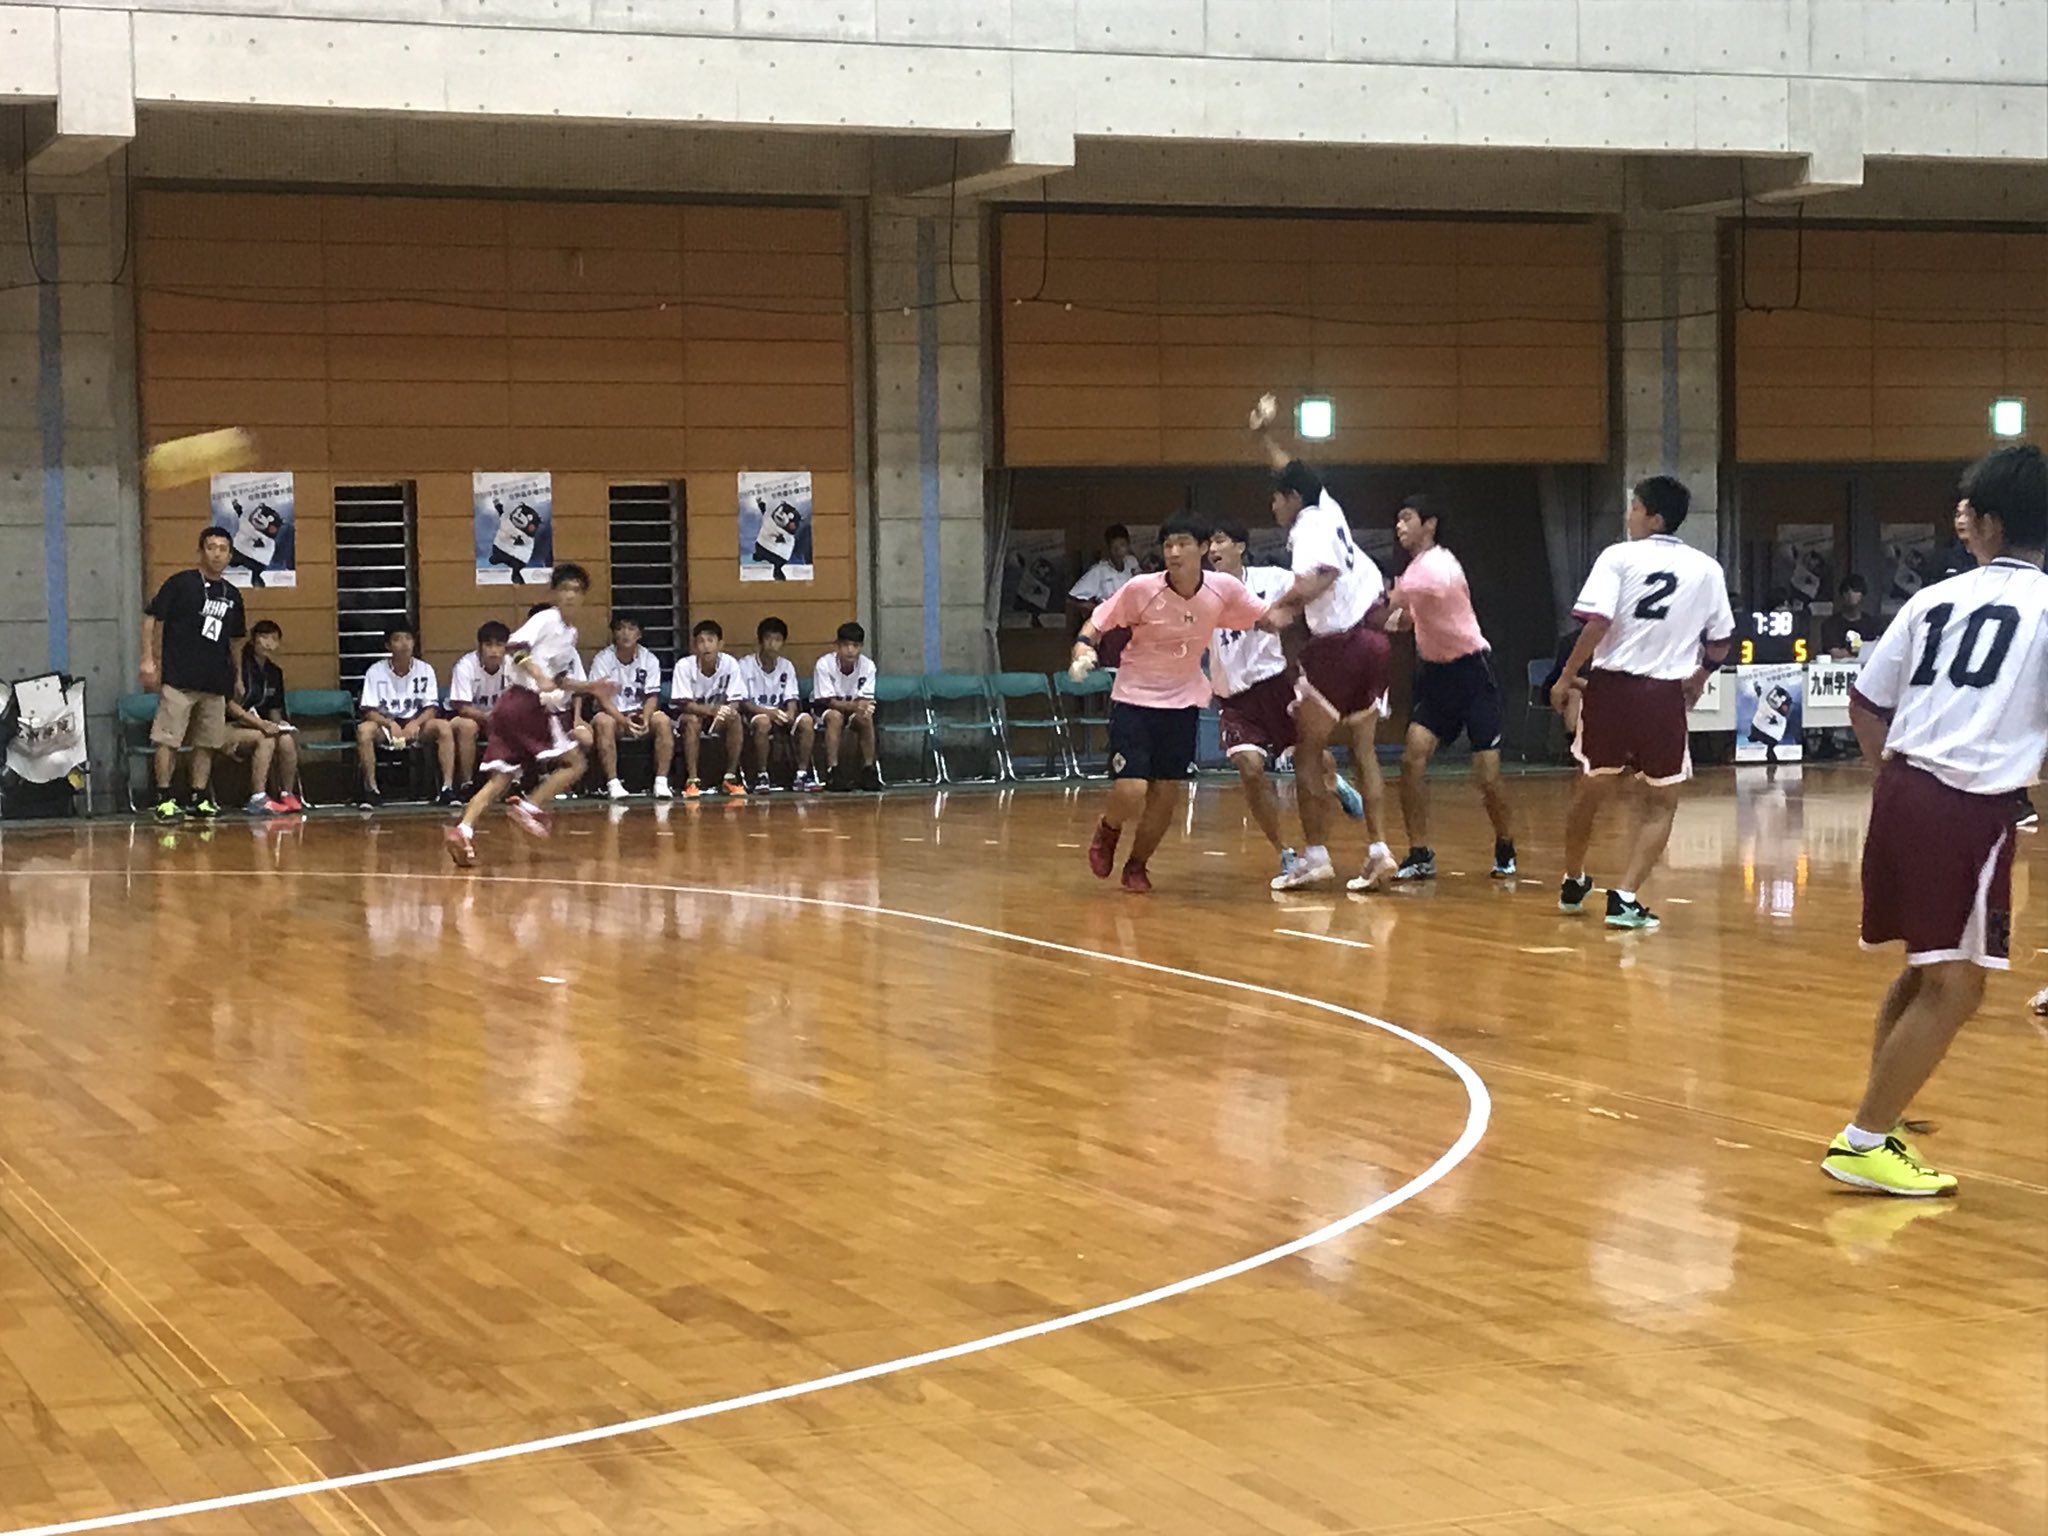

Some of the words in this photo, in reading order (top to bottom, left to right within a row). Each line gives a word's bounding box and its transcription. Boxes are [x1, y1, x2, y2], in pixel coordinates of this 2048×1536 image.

[1634, 571, 1678, 620] 2
[205, 620, 216, 639] A
[1752, 611, 1793, 636] 7:38
[1741, 640, 1754, 664] 3
[1794, 639, 1807, 662] 5
[1910, 602, 2021, 688] 10
[412, 677, 428, 693] 17
